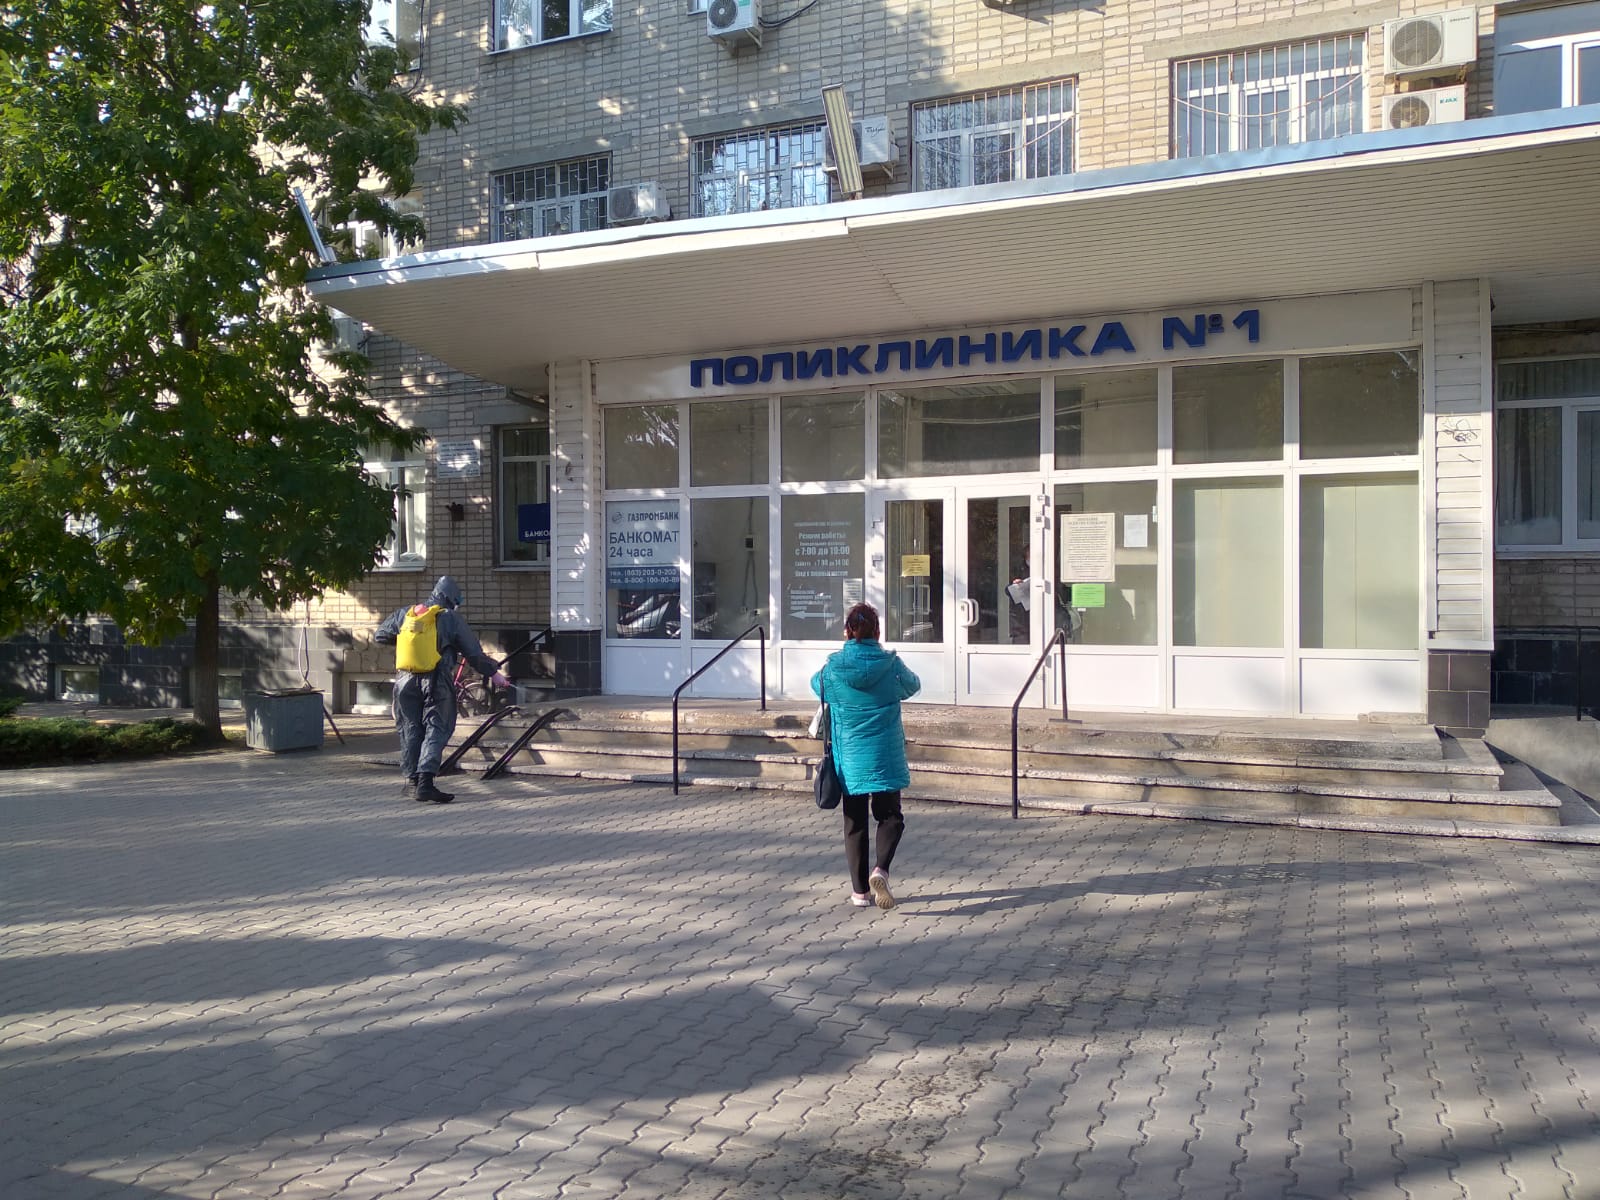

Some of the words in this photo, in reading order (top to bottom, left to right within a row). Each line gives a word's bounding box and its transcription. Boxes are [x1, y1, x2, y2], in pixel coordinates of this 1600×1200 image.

[690, 321, 1137, 387] ПОЛИКЛИНИКА
[627, 511, 679, 522] ГАЗПРОМБАНК
[609, 530, 680, 544] БАНКОМАТ
[609, 546, 623, 558] 24
[626, 548, 653, 558] часа
